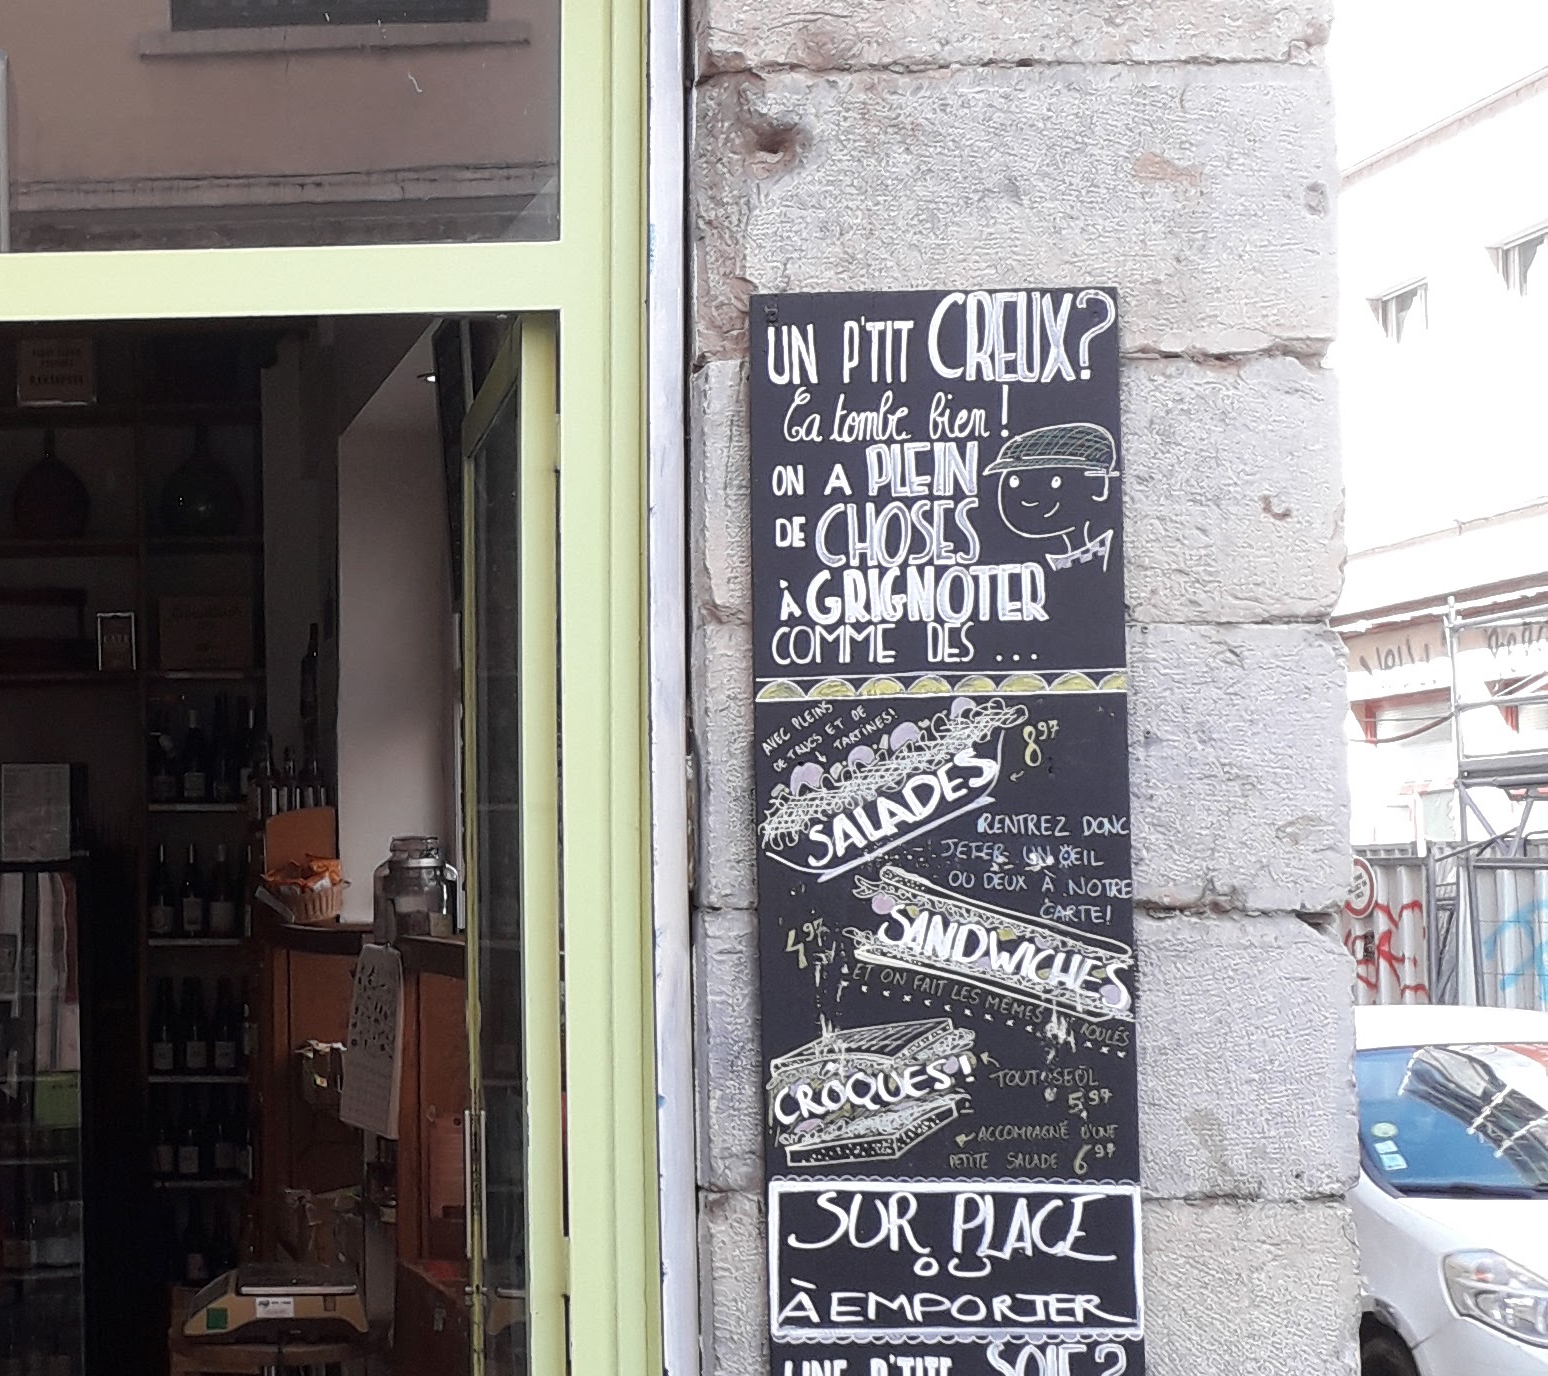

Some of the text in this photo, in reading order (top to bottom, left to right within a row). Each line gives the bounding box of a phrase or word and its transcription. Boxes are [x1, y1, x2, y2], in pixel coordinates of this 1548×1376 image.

[767, 323, 818, 385] UN
[843, 315, 914, 384] P'TIT
[829, 389, 912, 443] tombe
[771, 441, 979, 497] ON A PLEIN
[775, 497, 980, 567] DE CHOSES
[806, 563, 1049, 624] GRIGNOTER
[771, 622, 975, 665] COMME DES
[761, 700, 833, 756] AVEC PLEINS
[787, 704, 867, 760] TRUCS ET DE
[807, 747, 999, 869] SALADES
[977, 813, 1130, 837] RENTREZ DONC
[941, 838, 1010, 863] JETER
[948, 870, 975, 888] OU
[983, 872, 1028, 891] DEUX
[877, 903, 1132, 1011] SANDWICHES
[852, 964, 980, 1006] ET ON FAIT LES
[989, 1069, 1039, 1088] TOUT
[1006, 1152, 1058, 1170] SALADE
[787, 1191, 1117, 1261] SUR PLACE
[913, 1256, 992, 1278] OU
[830, 1291, 1138, 1324] EMPORTER
